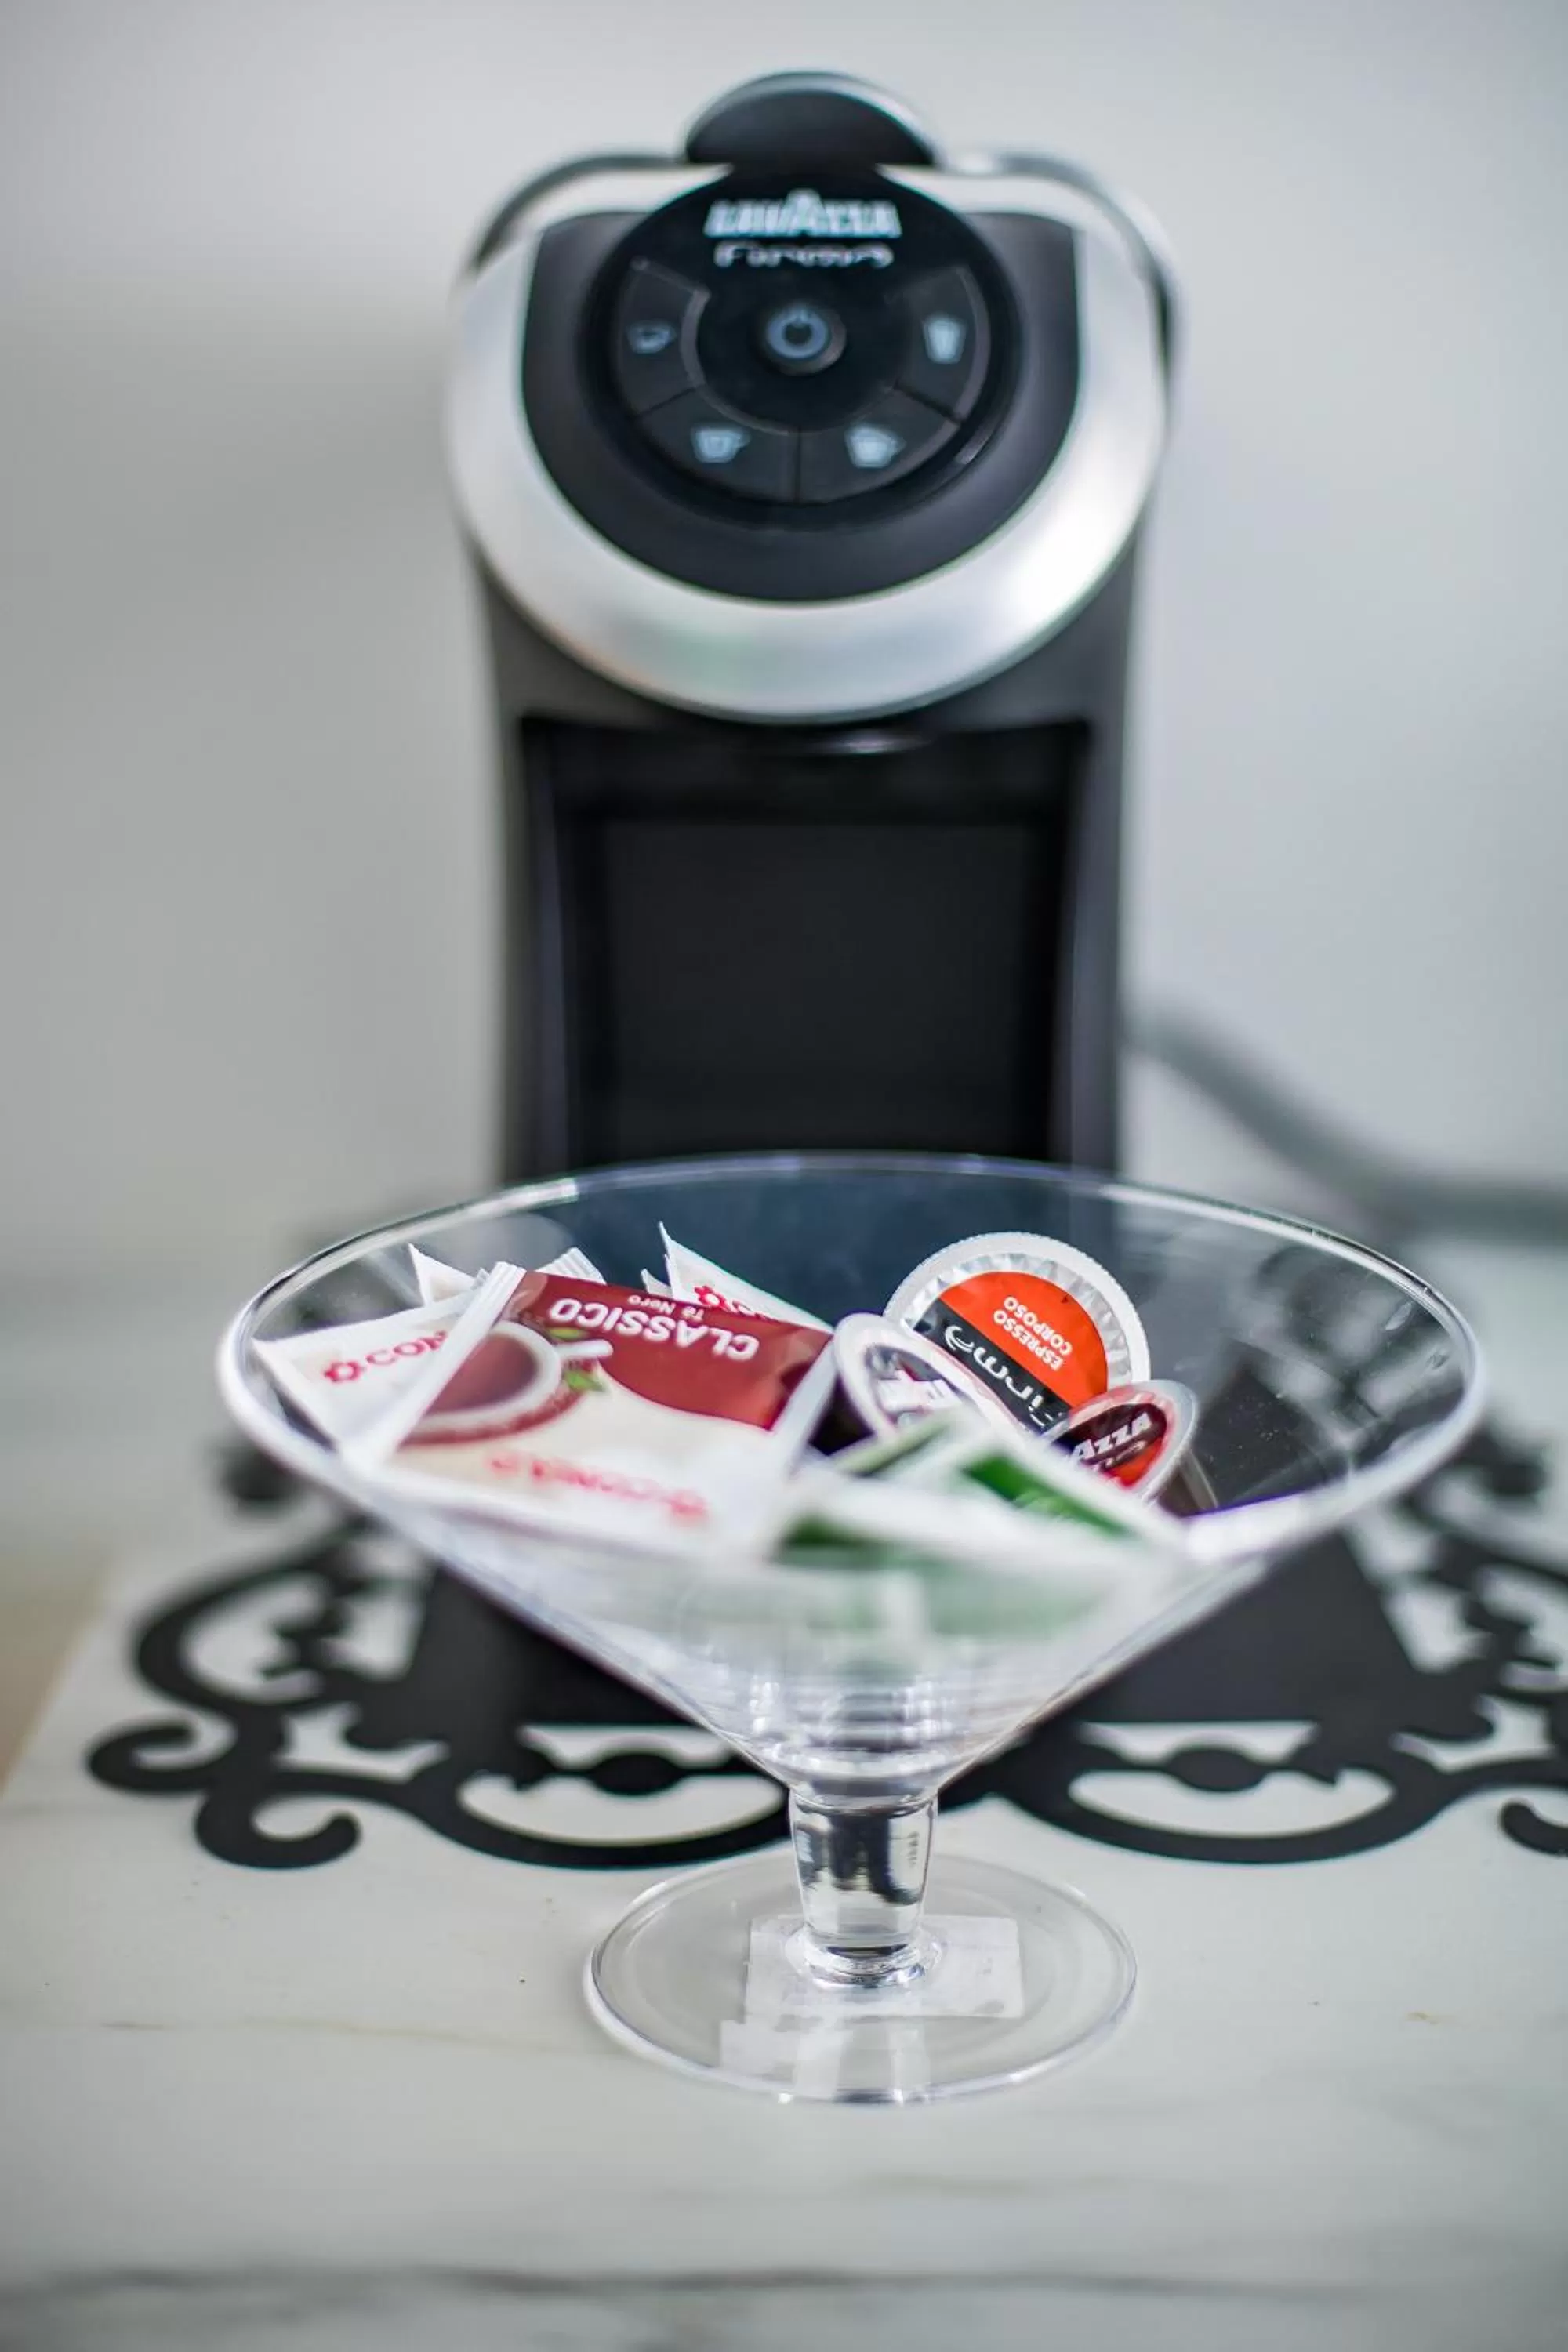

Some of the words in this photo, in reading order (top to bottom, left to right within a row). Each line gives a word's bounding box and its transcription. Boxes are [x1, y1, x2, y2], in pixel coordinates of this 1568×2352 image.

[549, 1298, 760, 1361] CLASSICO
[993, 1309, 1065, 1371] ESPRESSO
[1004, 1295, 1073, 1356] CORPOSO
